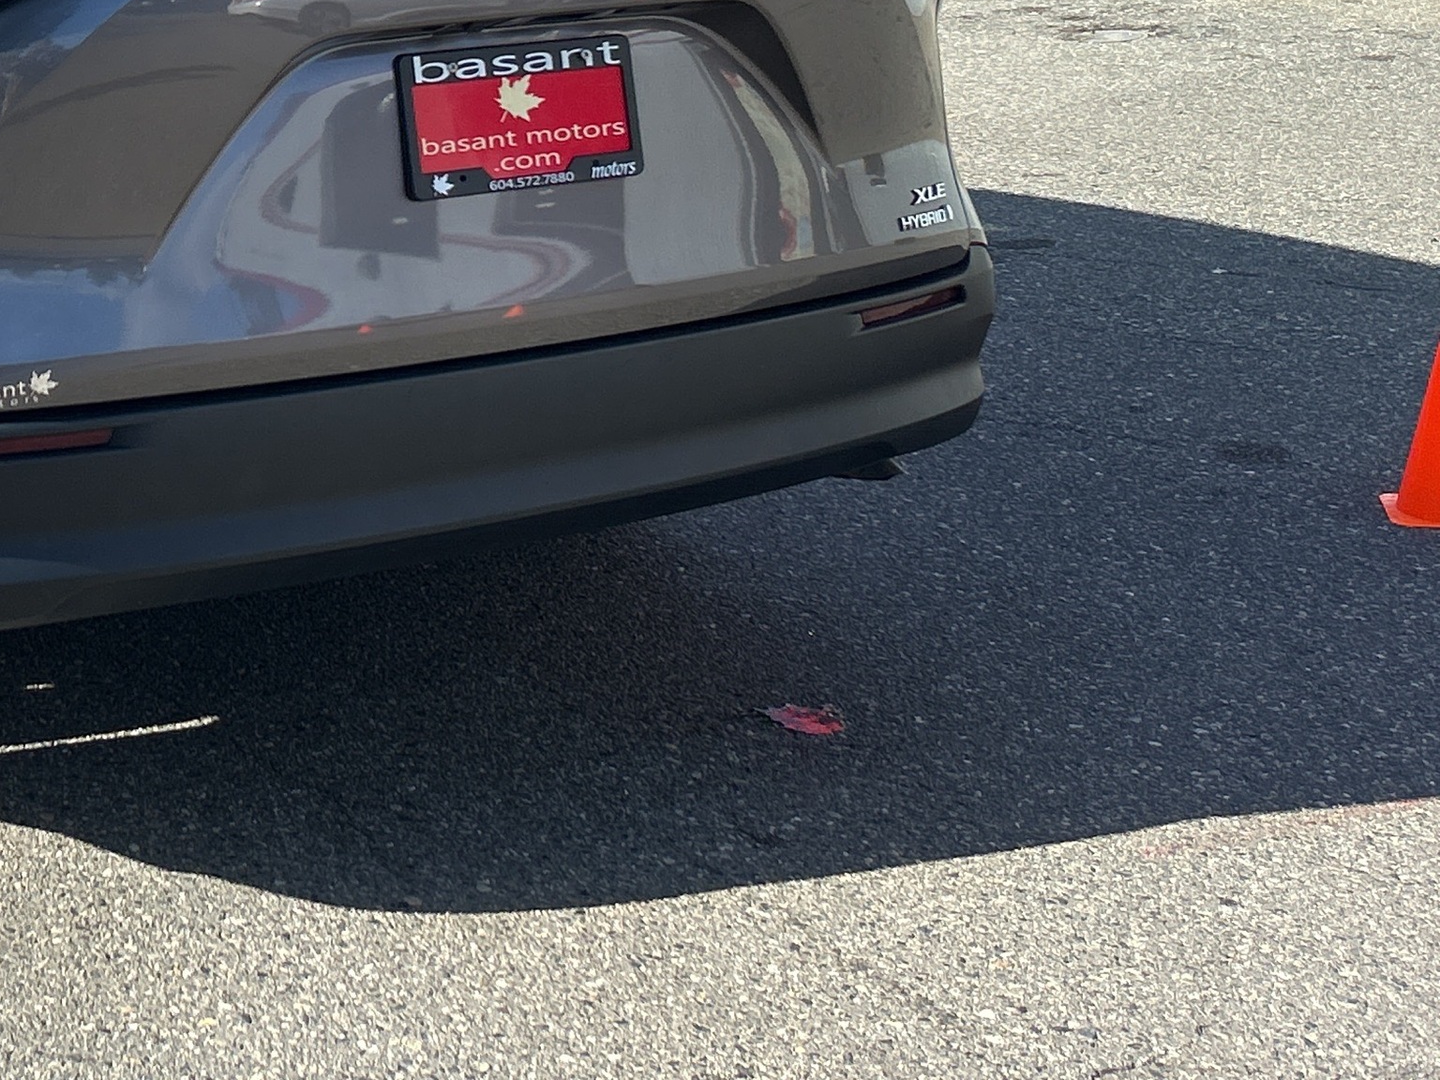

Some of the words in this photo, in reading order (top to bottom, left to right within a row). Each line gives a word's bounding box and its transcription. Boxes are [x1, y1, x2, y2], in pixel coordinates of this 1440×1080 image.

[413, 40, 621, 84] basant
[421, 131, 517, 157] basant
[526, 121, 626, 146] motors
[493, 150, 561, 172] .com
[590, 160, 637, 179] motors
[489, 171, 575, 191] 604.572.7880
[910, 182, 946, 206] XLE
[898, 205, 950, 232] HYBRID
